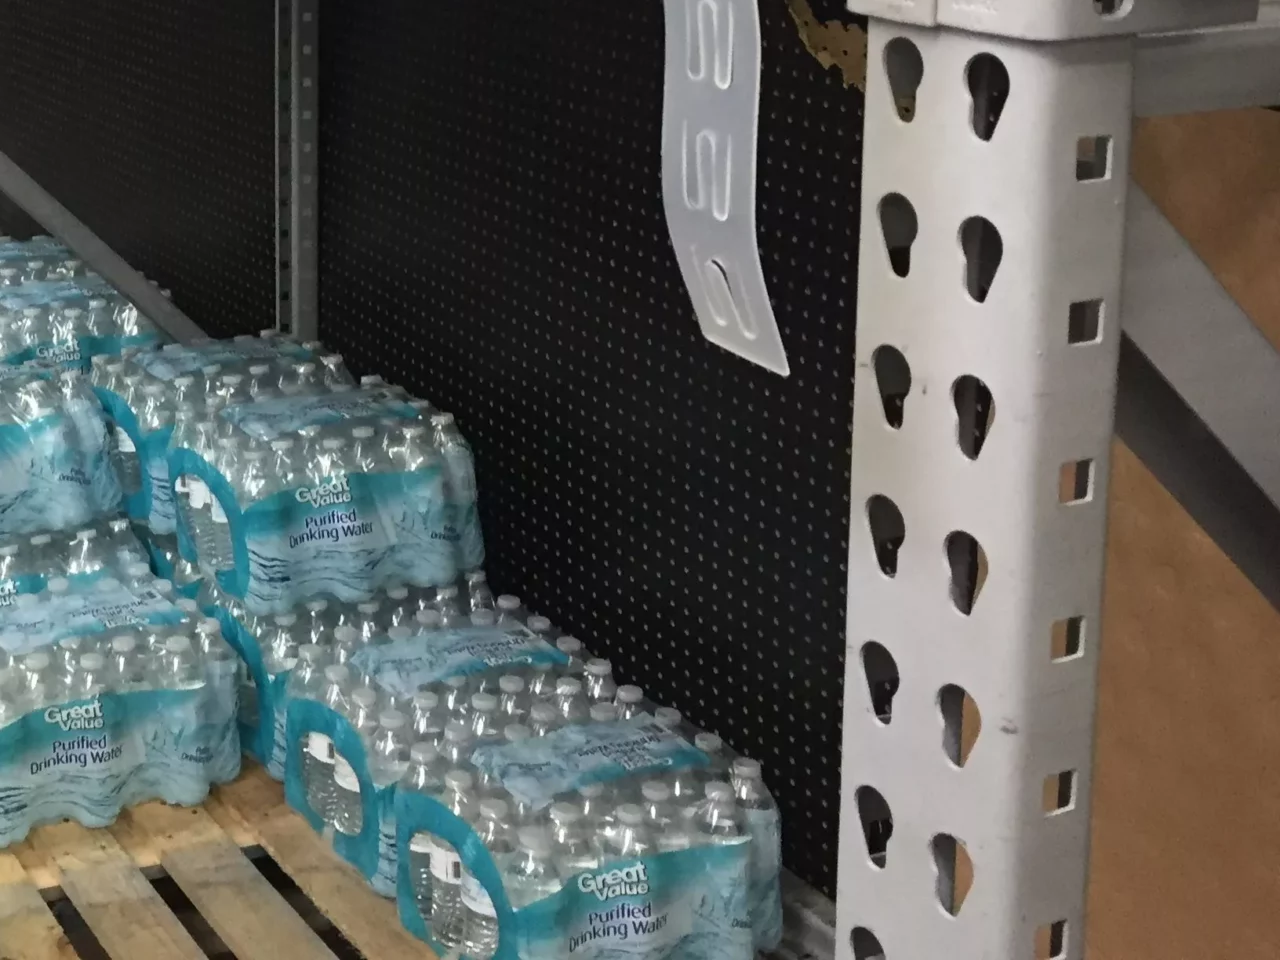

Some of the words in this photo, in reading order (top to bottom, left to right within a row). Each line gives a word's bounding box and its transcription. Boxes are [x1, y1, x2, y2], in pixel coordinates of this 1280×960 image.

[295, 476, 350, 503] Great
[310, 492, 352, 508] Value
[305, 508, 357, 529] Purified
[289, 525, 340, 549] Drinking
[341, 521, 373, 538] Water
[44, 700, 103, 723] Great
[59, 717, 104, 731] Value
[52, 735, 107, 754] Purified
[30, 751, 87, 775] Drinking
[577, 861, 648, 893] Great
[594, 882, 649, 901] Value
[588, 903, 652, 926] Purified
[569, 922, 628, 953] Drinking
[633, 913, 669, 936] Water
